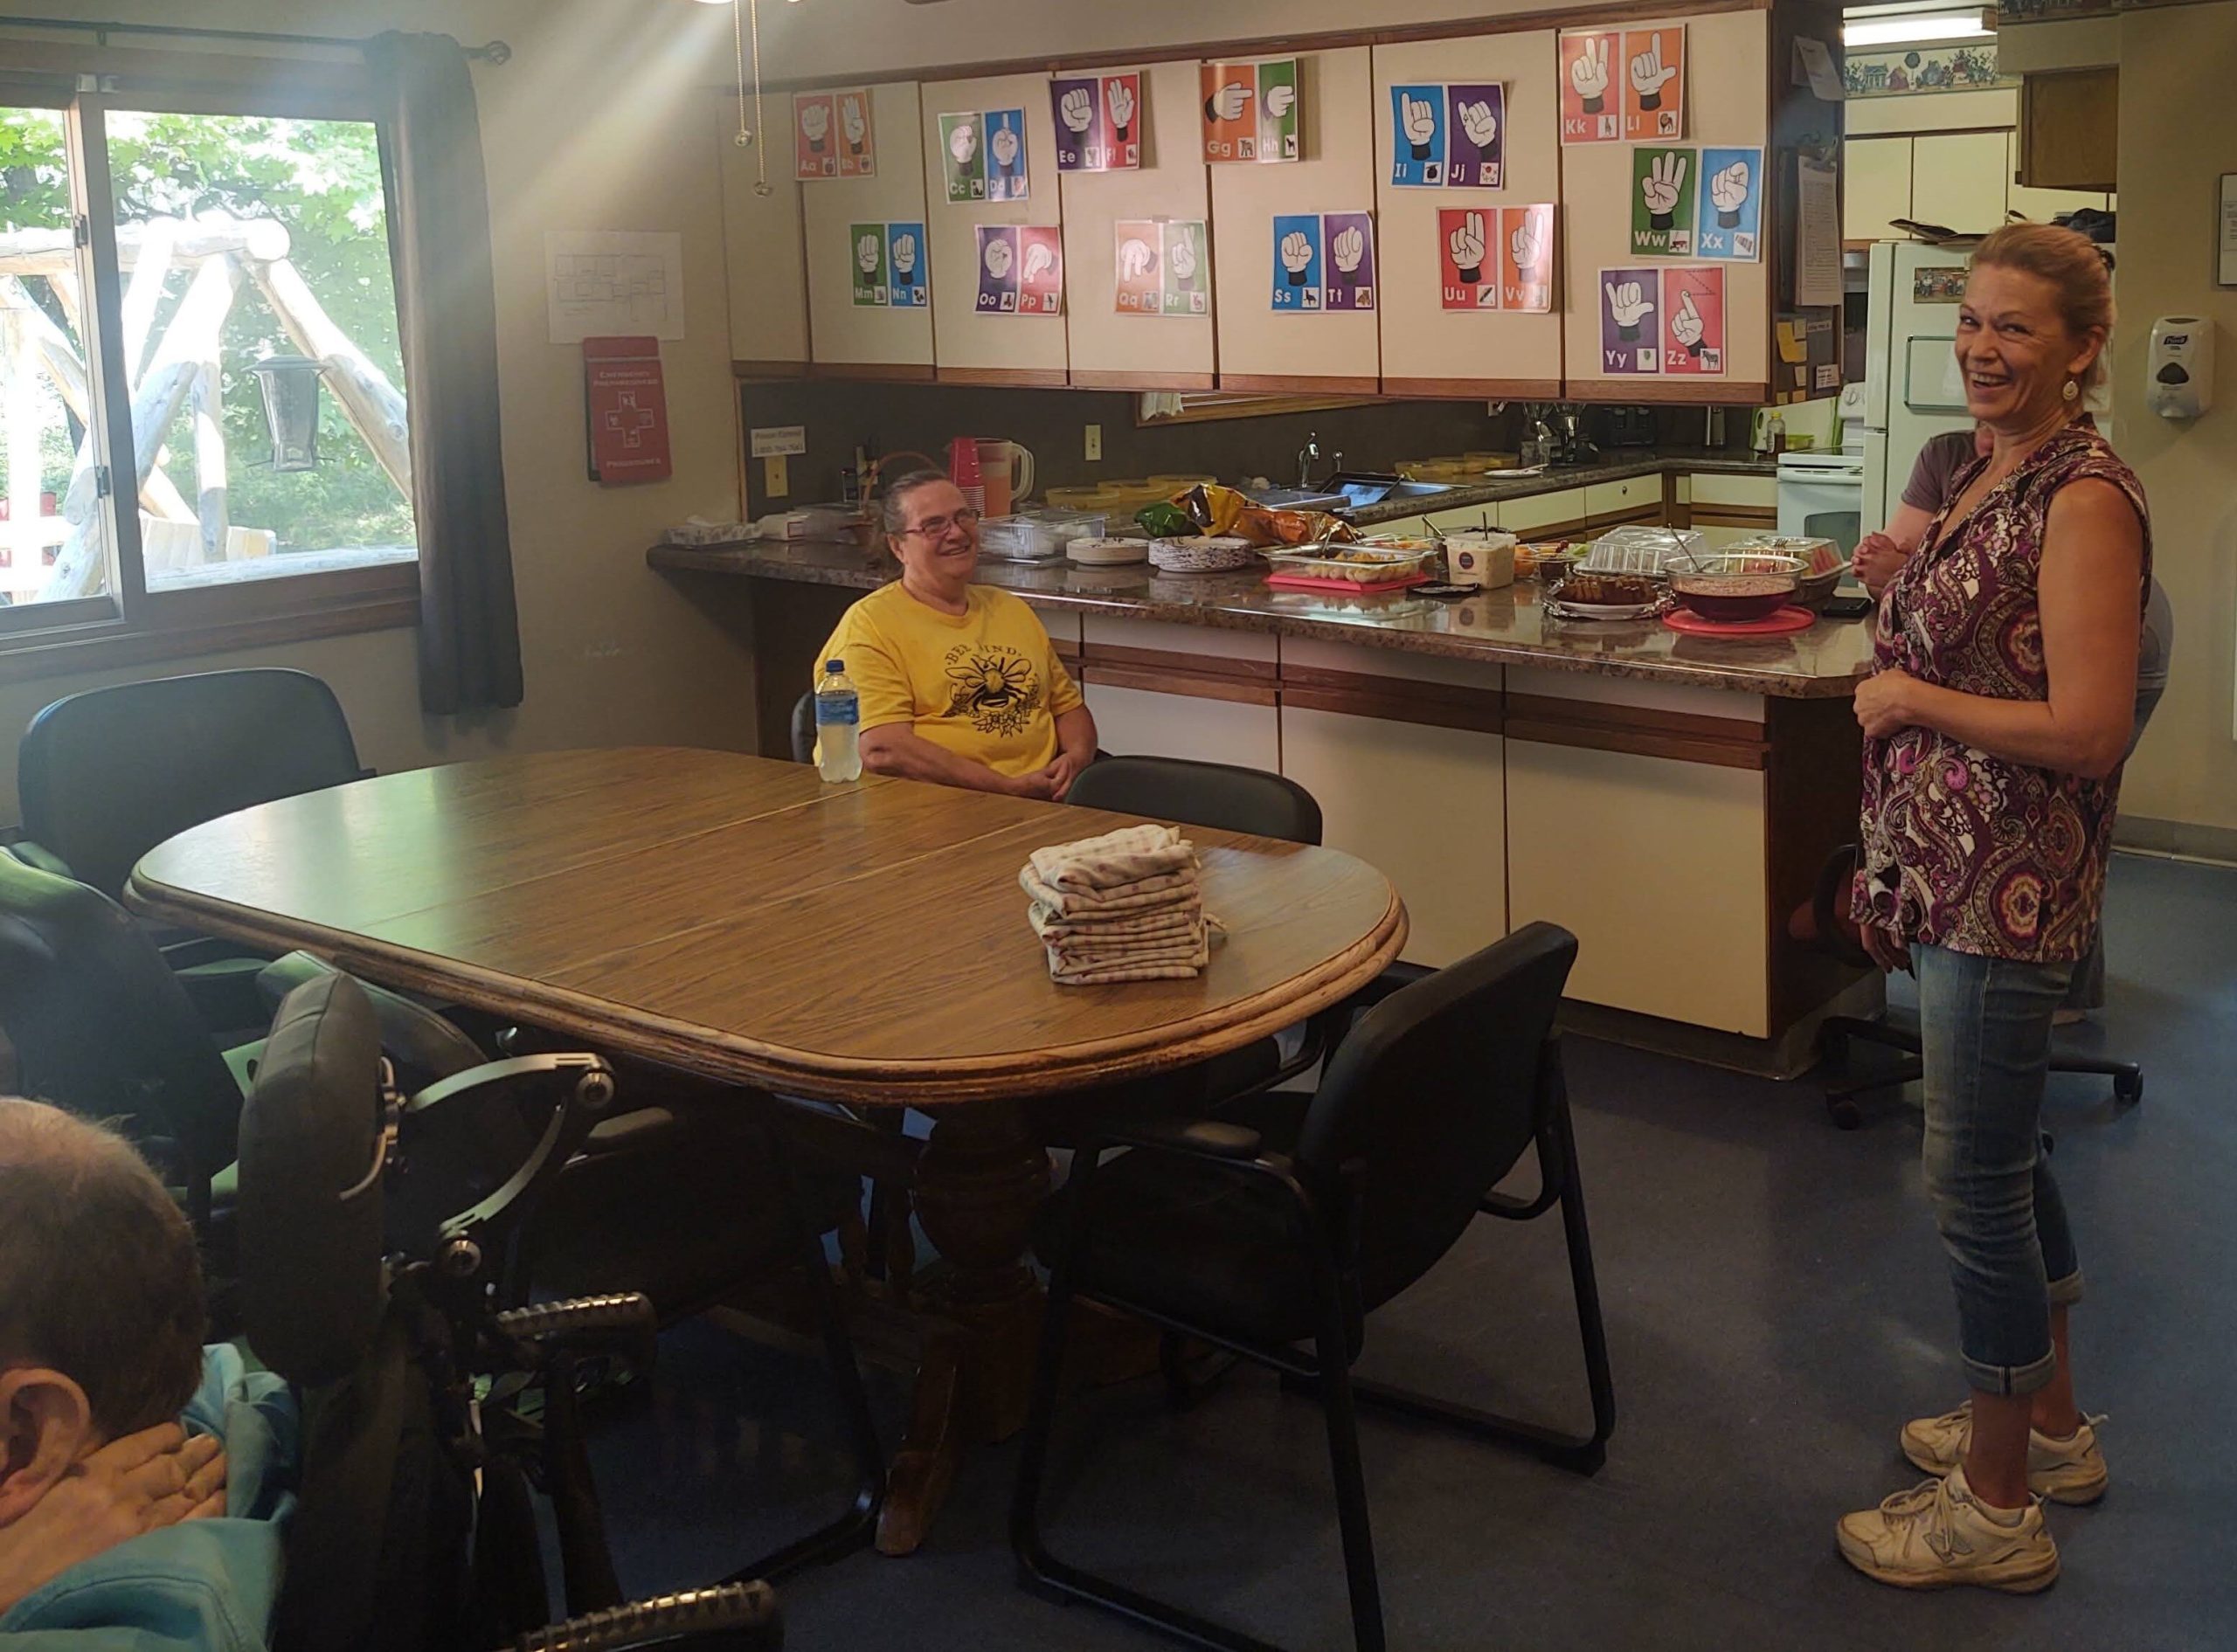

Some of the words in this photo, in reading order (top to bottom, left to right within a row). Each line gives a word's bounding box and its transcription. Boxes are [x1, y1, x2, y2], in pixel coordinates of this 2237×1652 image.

[1565, 119, 1586, 134] Kk
[1208, 141, 1230, 157] Gg
[1264, 137, 1278, 152] Hh
[1059, 149, 1076, 163] Ee
[1395, 163, 1407, 178] Ii
[1451, 163, 1465, 182] Jj
[950, 182, 966, 194] Cc
[1634, 231, 1666, 247] Ww
[1700, 232, 1723, 249] Xx
[855, 287, 873, 299] Mm
[892, 287, 906, 300] Nn
[980, 293, 996, 305] Oo
[1119, 293, 1137, 308] Qq
[1166, 293, 1179, 307] Rr
[1274, 288, 1292, 302] Ss
[1328, 288, 1342, 302] Tt
[1444, 287, 1465, 301] Uu
[1505, 287, 1524, 301] Vv
[1022, 294, 1035, 309] Pp
[1605, 350, 1627, 368] Yy
[1666, 349, 1686, 365] Zz
